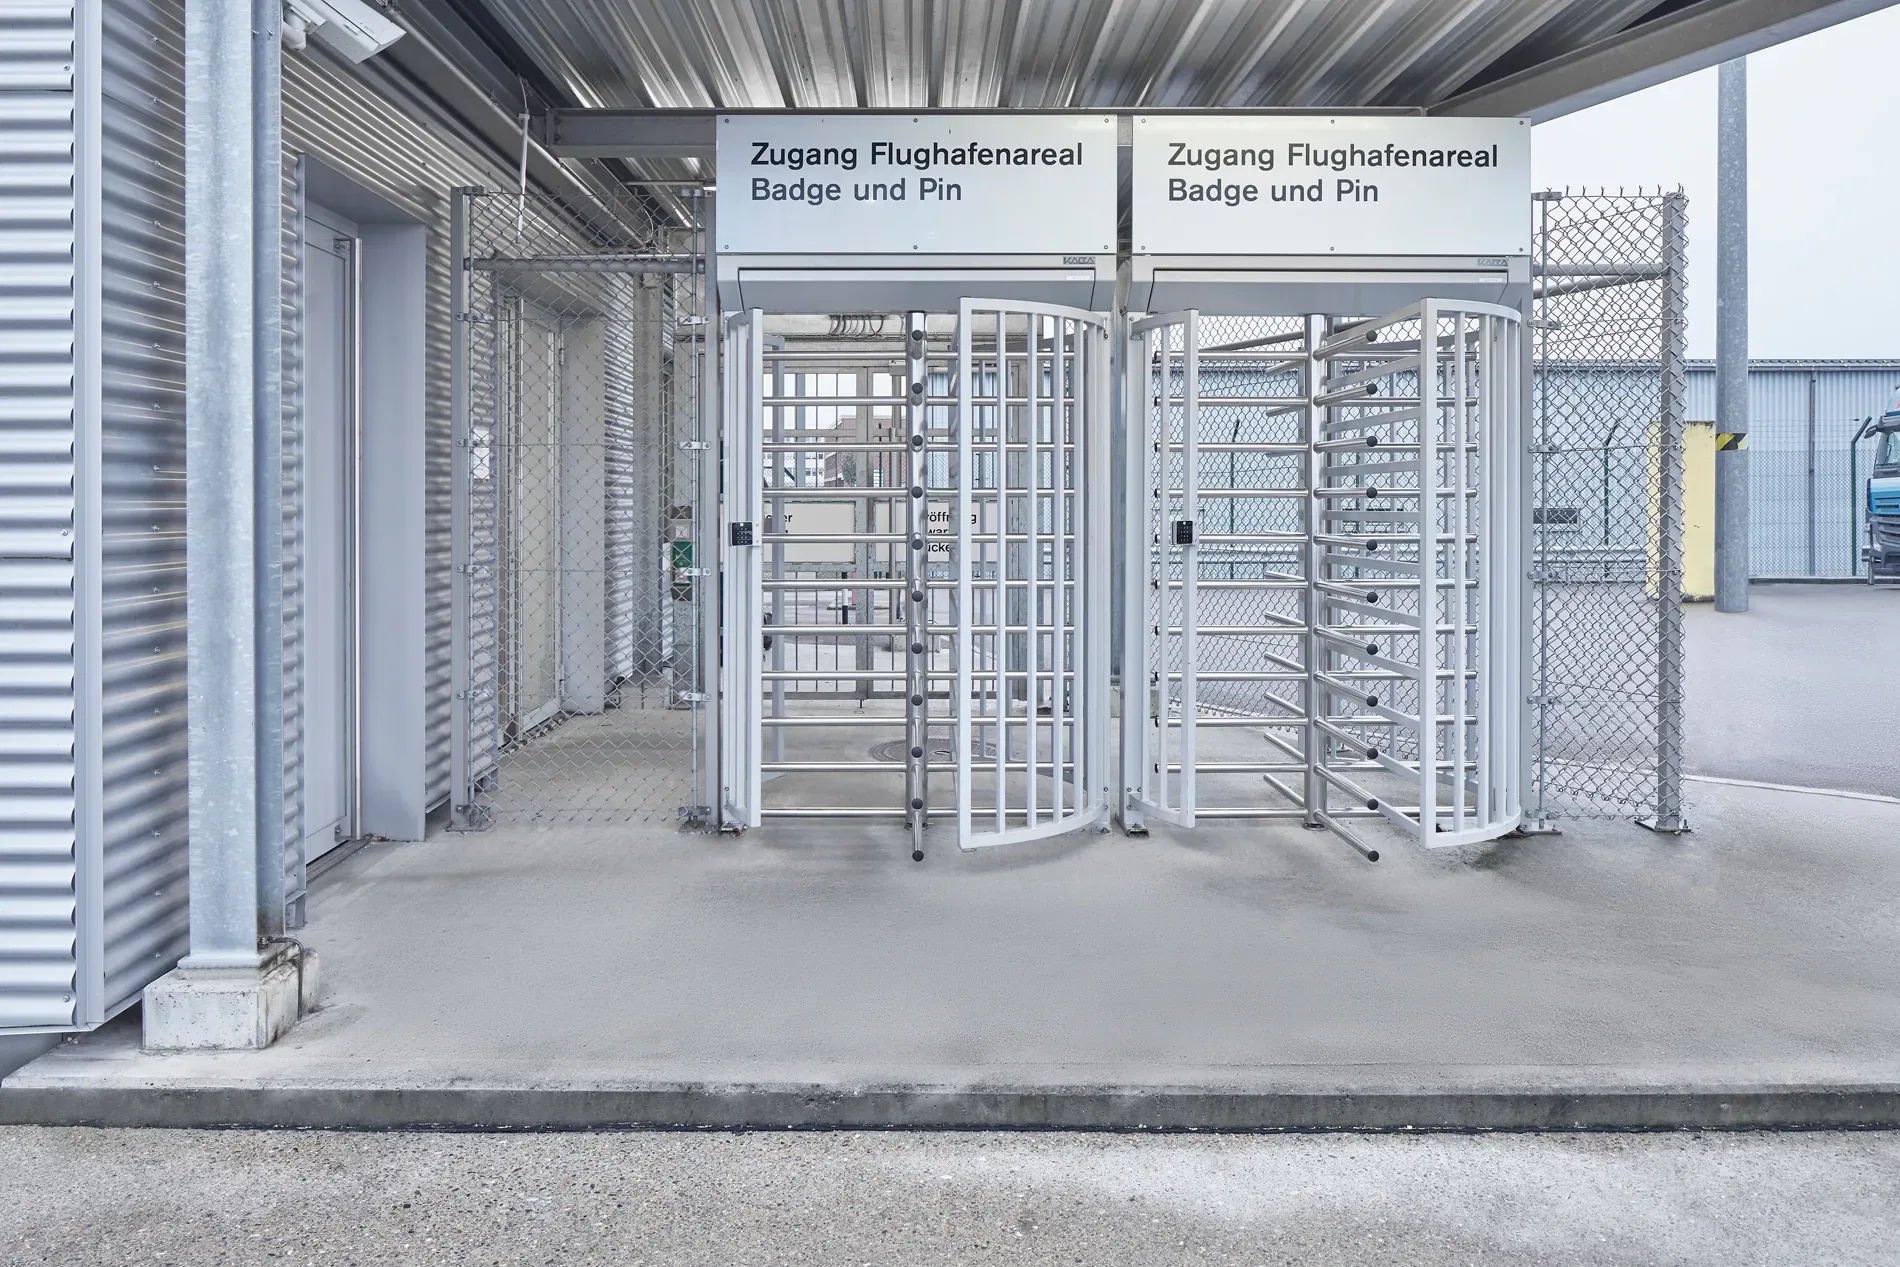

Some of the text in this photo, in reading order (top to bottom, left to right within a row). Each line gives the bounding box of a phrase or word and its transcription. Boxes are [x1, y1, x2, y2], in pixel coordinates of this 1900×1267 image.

[751, 142, 1082, 170] Zugang Flughafenareal
[1167, 143, 1498, 171] Zugang Flughafenareal
[752, 178, 962, 206] Badge und Pin
[1168, 179, 1379, 207] Badge und Pin
[1063, 256, 1096, 265] KABA
[1477, 258, 1509, 267] KABA
